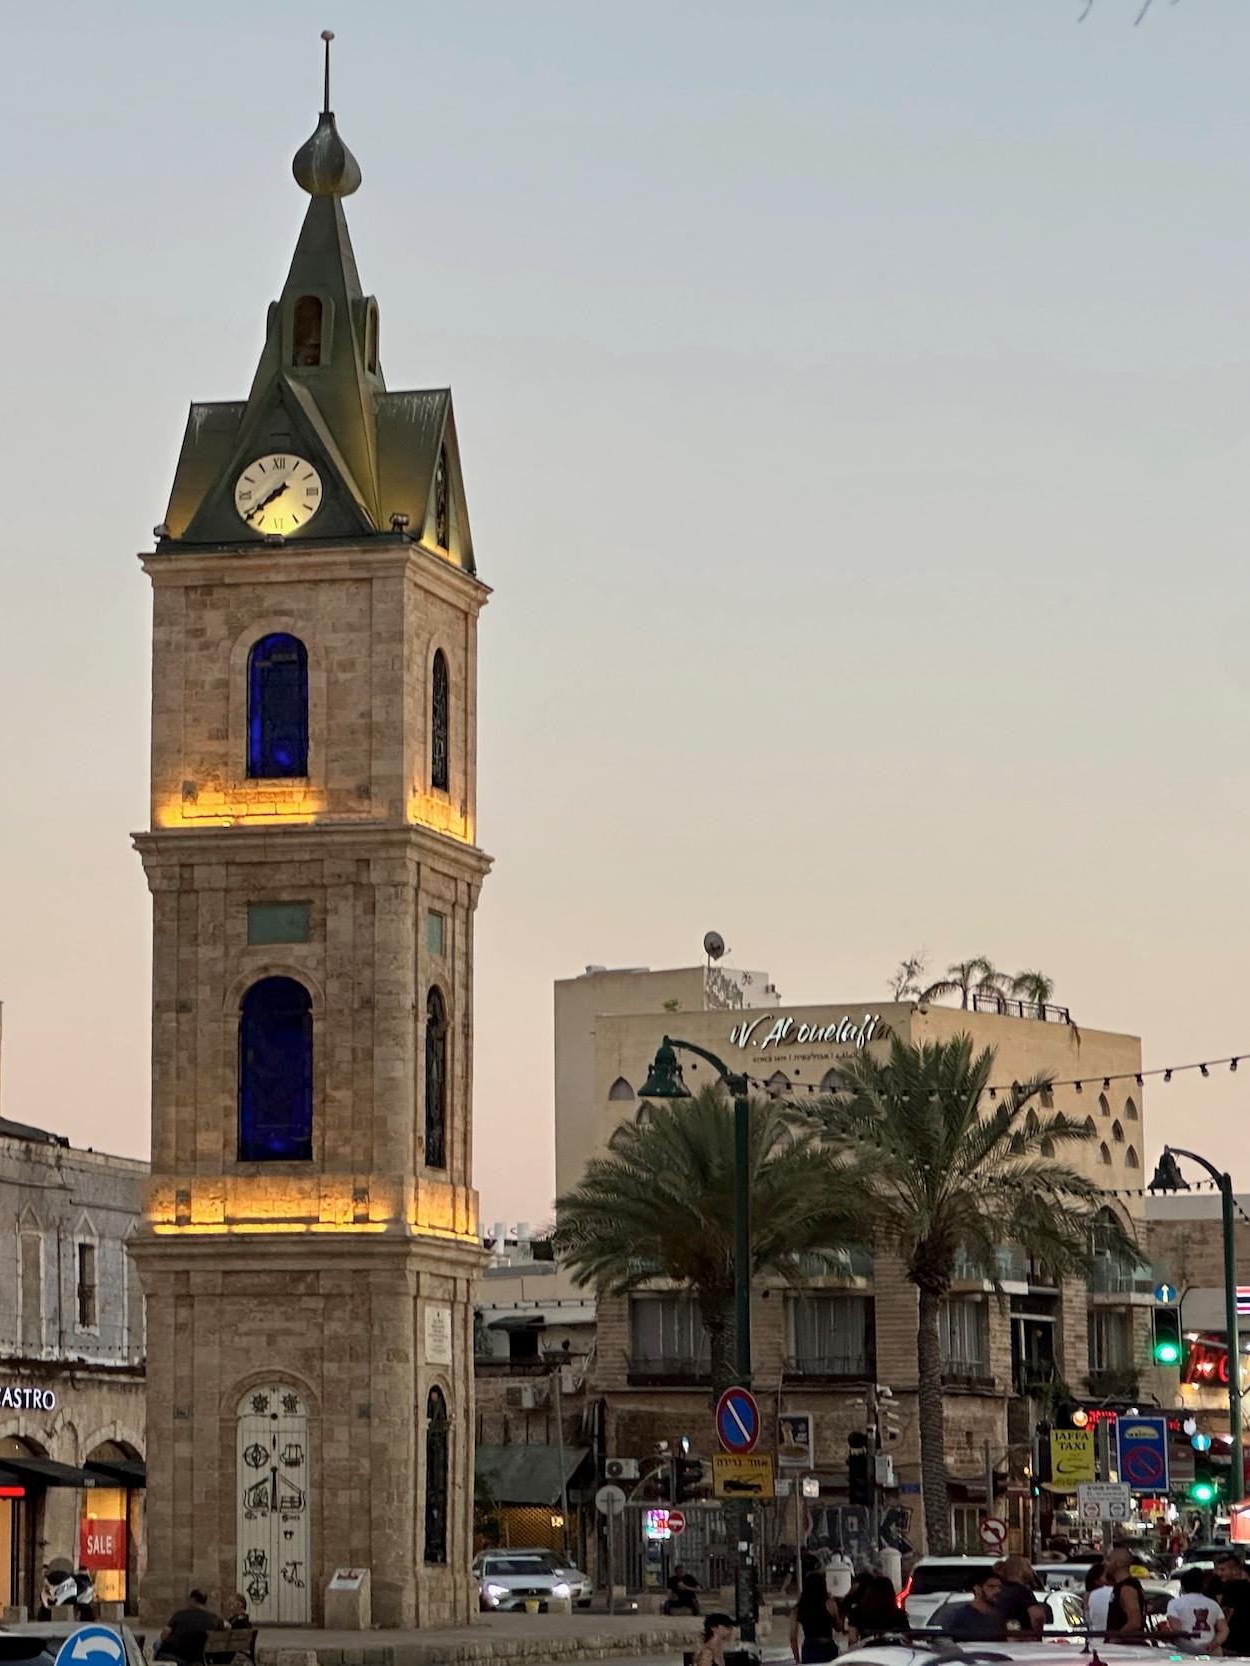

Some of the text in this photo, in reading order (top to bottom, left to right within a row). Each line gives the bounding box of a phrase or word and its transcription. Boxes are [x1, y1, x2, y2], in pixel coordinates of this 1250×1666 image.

[272, 457, 286, 470] XII
[1055, 1431, 1089, 1441] JAFFA
[1058, 1442, 1086, 1451] TAXI
[86, 1535, 113, 1555] SALE
